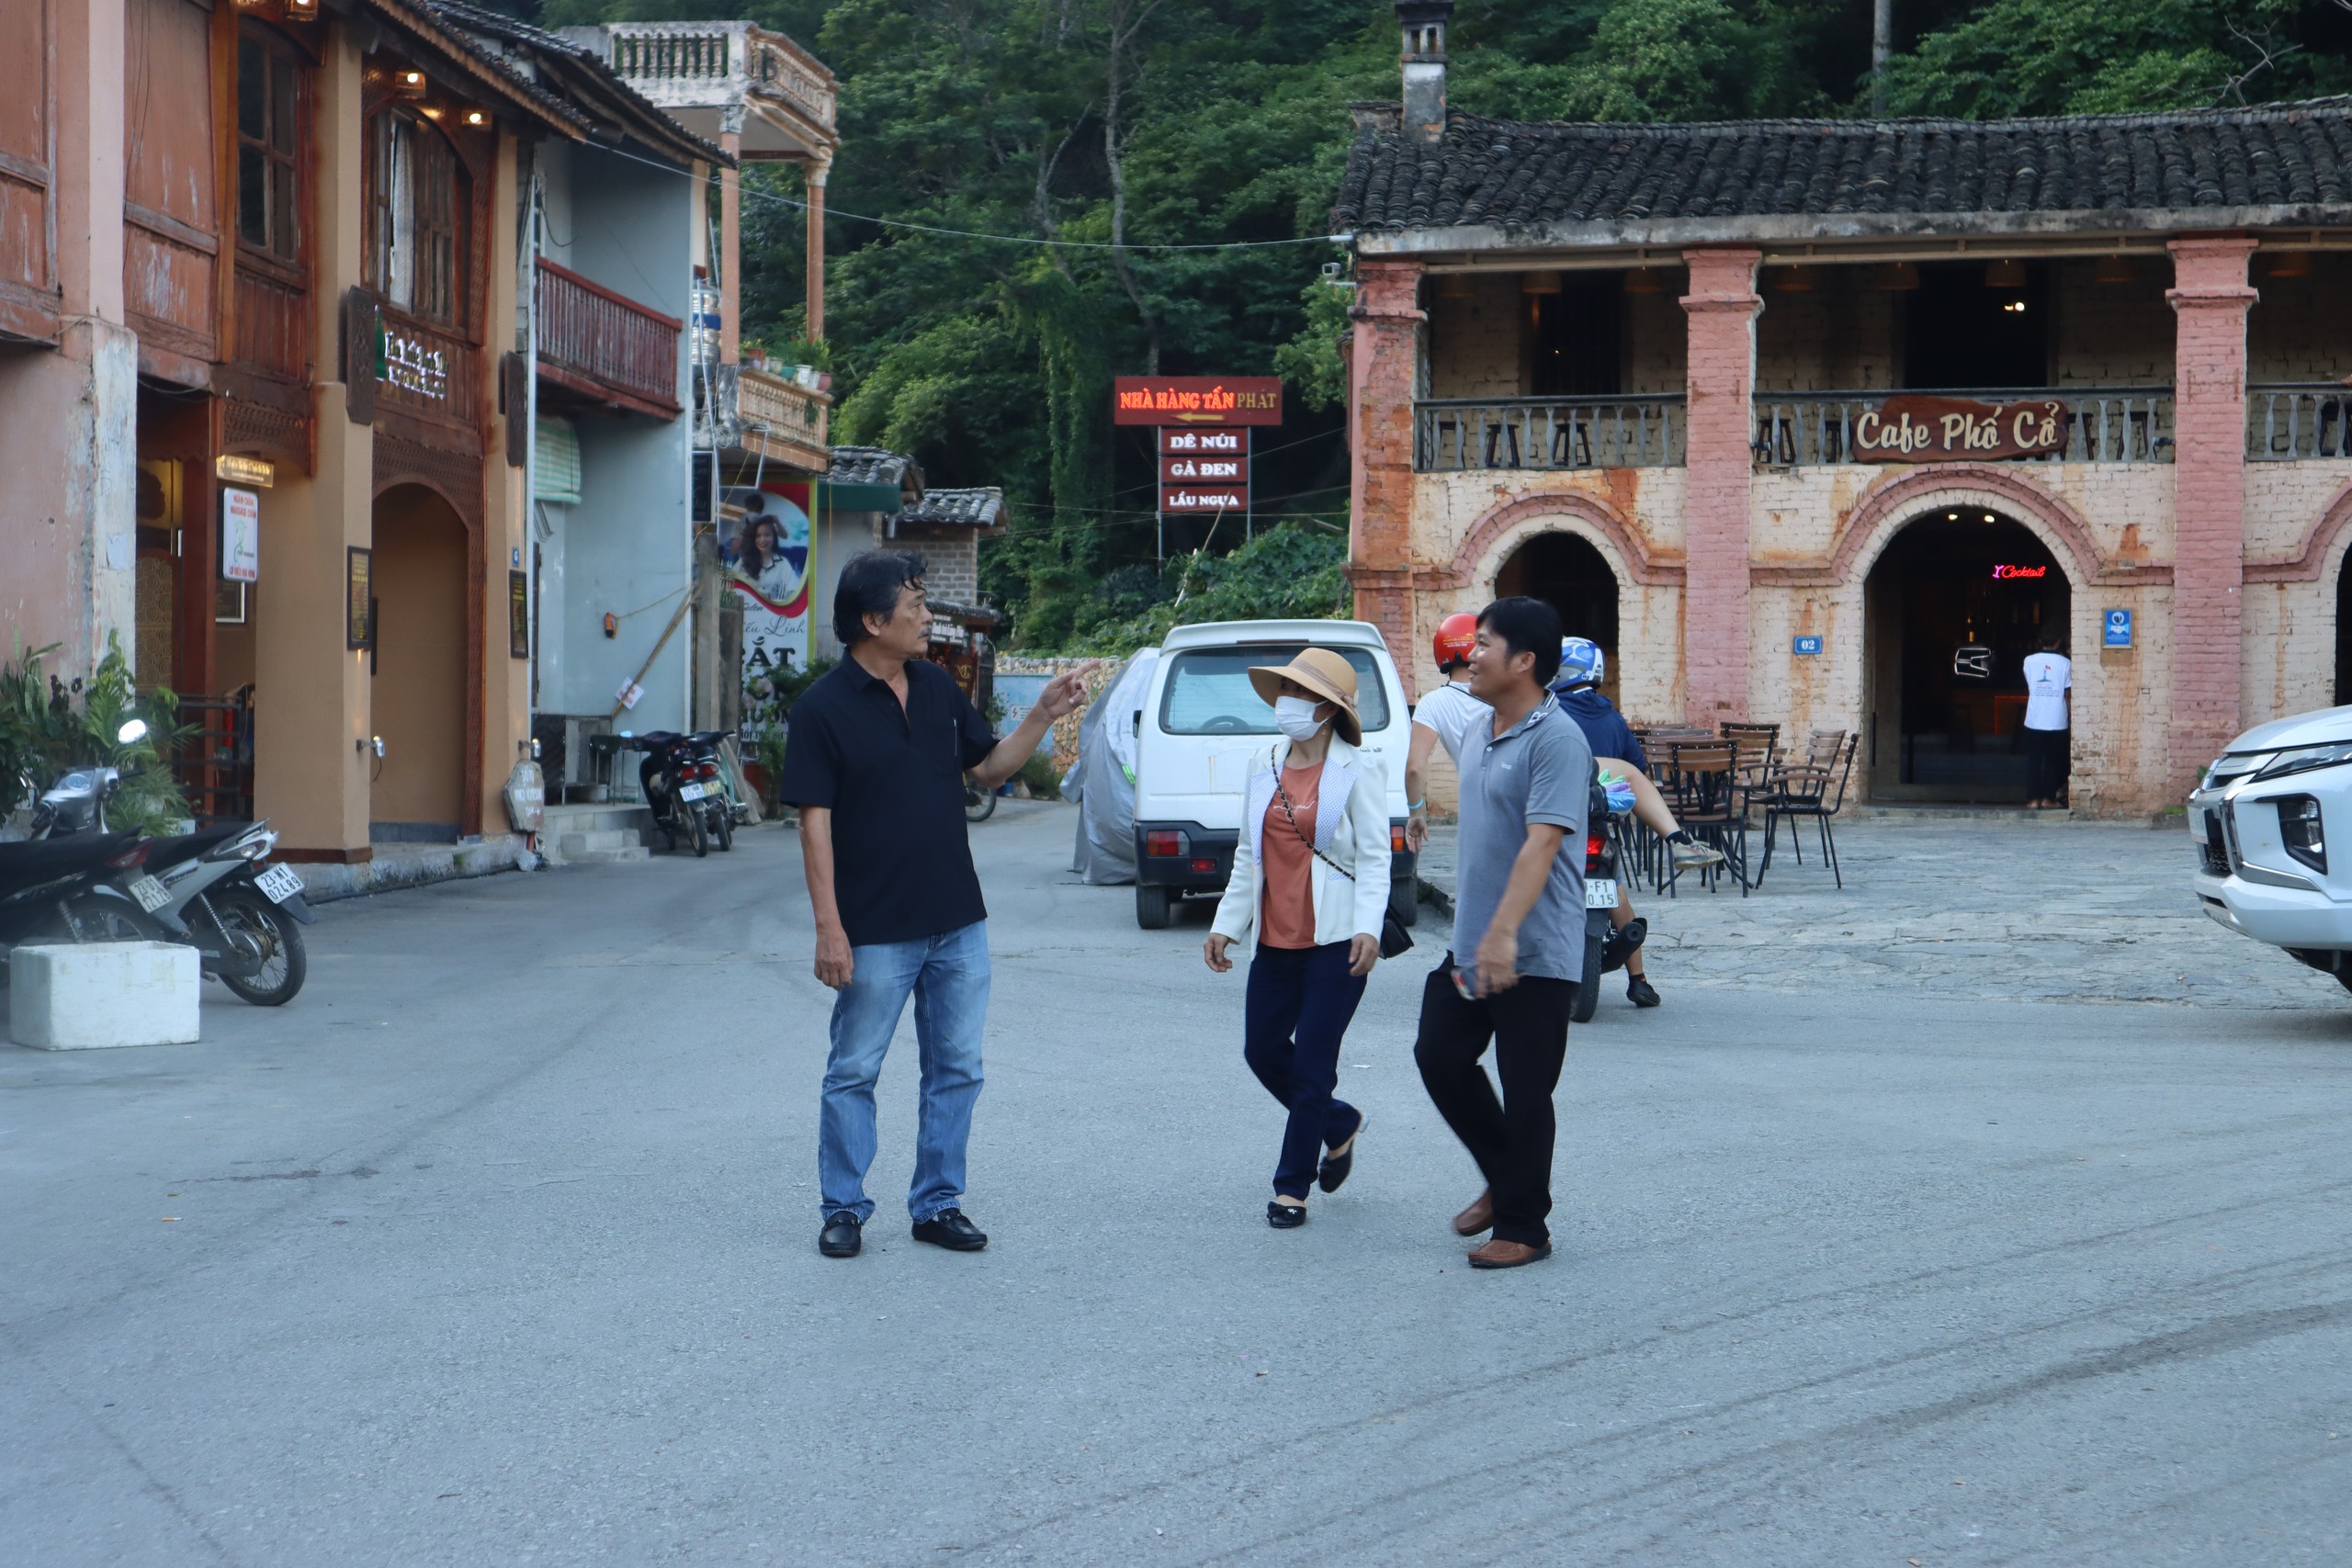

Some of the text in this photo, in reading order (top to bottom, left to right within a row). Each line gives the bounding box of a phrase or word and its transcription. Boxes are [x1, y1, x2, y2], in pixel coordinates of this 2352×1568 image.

[1120, 387, 1154, 409] NHÀ
[1156, 387, 1200, 410] HÀNG
[1202, 385, 1235, 409] TẤN
[1857, 401, 2060, 454] Cafe Phố Cổ
[1170, 433, 1238, 448] DÊ NÚI
[1170, 460, 1238, 476] GÀ ĐEN
[2002, 565, 2046, 579] Cocktail
[764, 615, 806, 637] Linh
[741, 636, 796, 667] ẮT
[1801, 639, 1815, 650] 02
